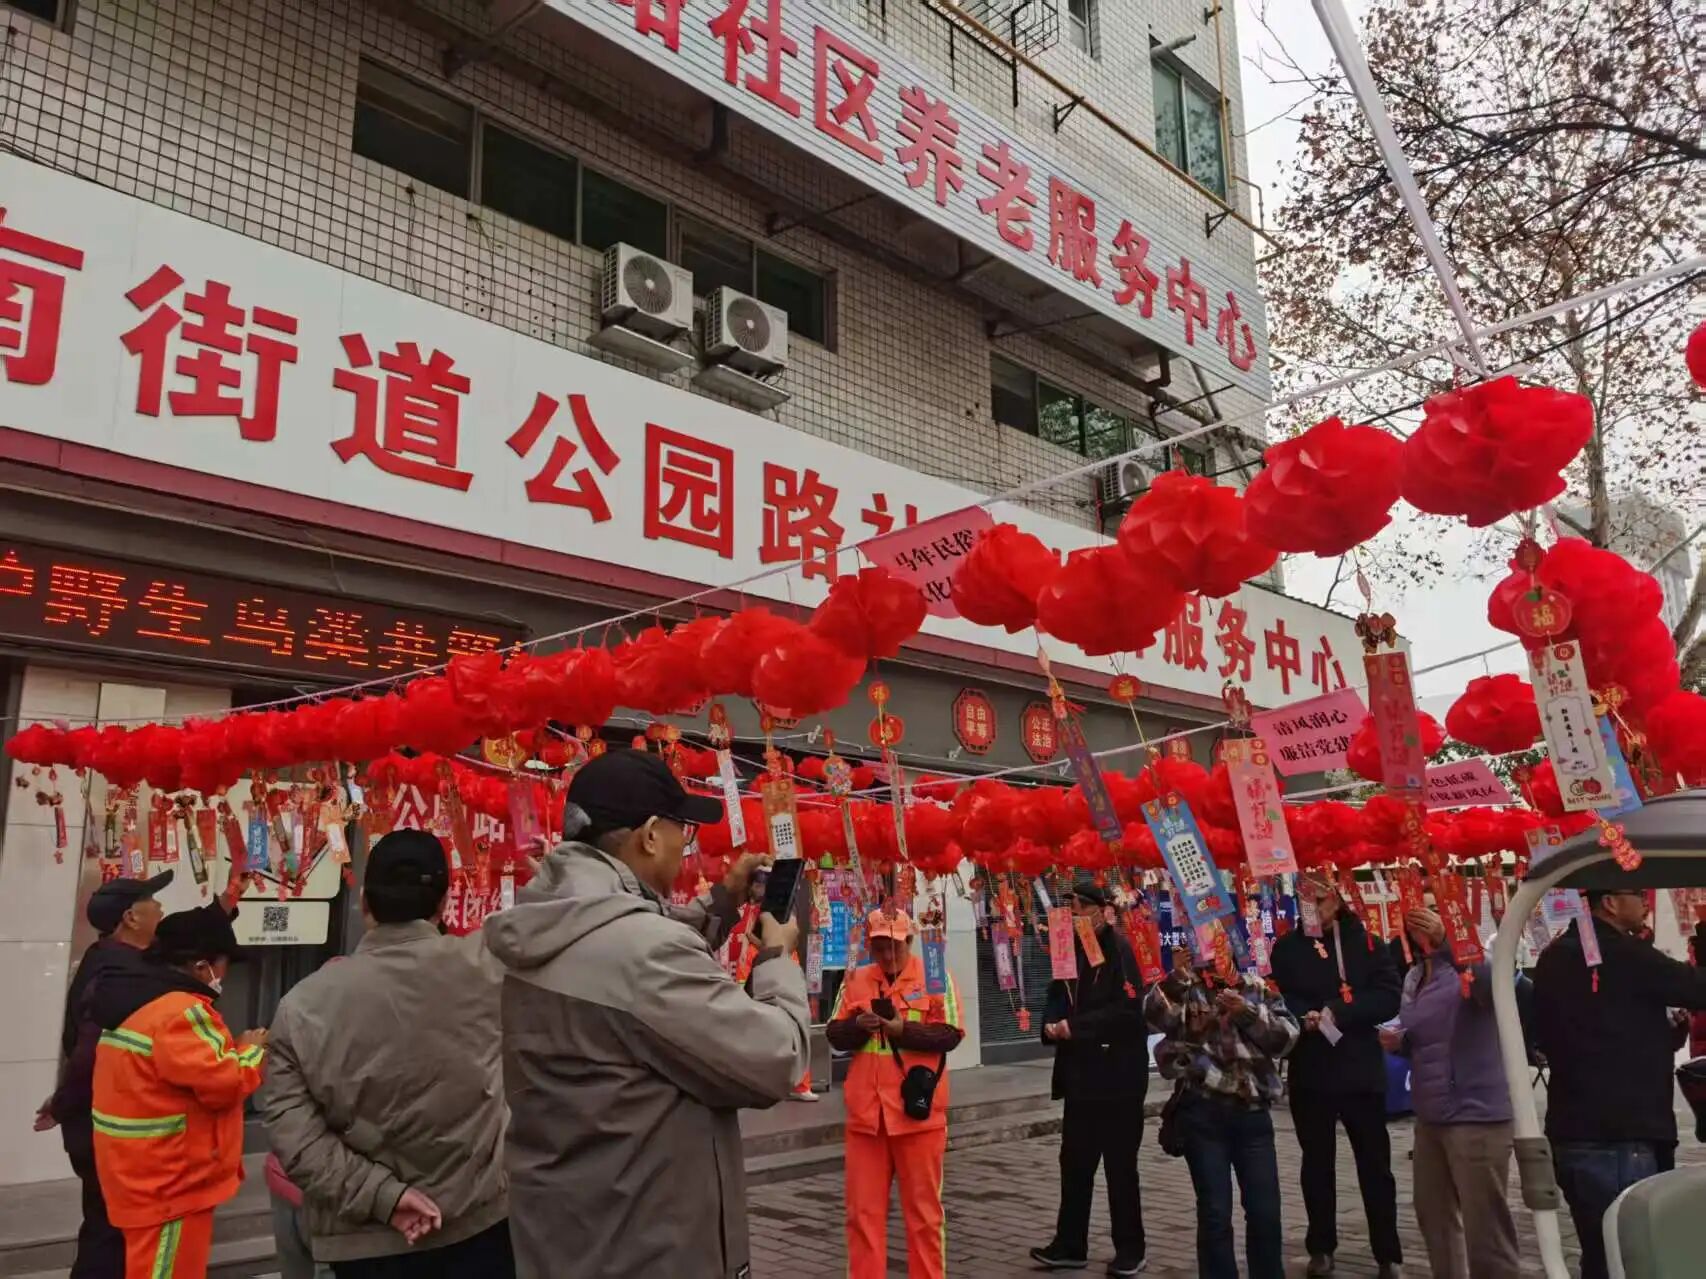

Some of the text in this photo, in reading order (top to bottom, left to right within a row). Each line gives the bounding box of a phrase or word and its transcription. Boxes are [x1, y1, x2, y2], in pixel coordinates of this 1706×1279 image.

[615, 0, 1257, 372] 社区养老服务中心
[0, 207, 917, 583] 街道公园路
[1428, 771, 1478, 788] 色低碳
